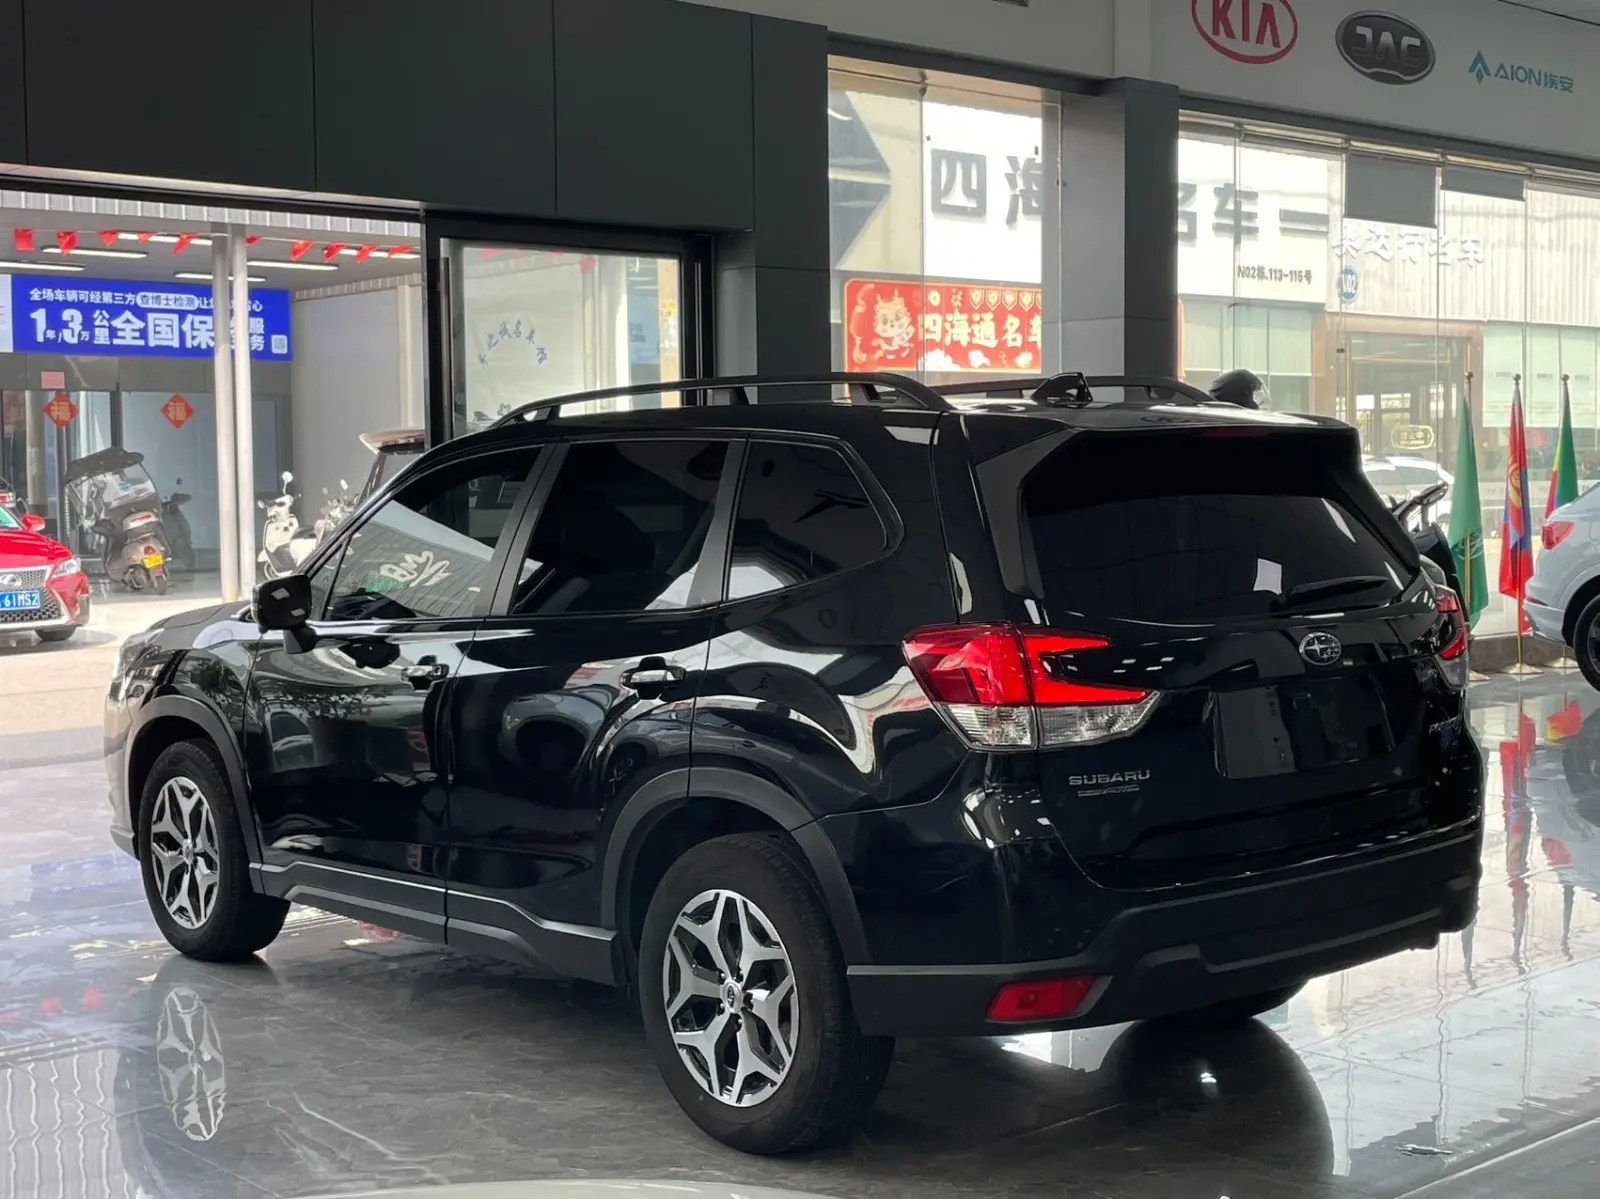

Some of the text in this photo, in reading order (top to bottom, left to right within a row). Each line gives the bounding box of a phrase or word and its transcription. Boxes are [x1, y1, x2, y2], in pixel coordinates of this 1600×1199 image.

[1212, 0, 1281, 48] KIA
[1352, 25, 1421, 69] JAC
[51, 401, 72, 421] 福
[167, 401, 187, 421] 福
[1068, 769, 1151, 786] SUBARU
